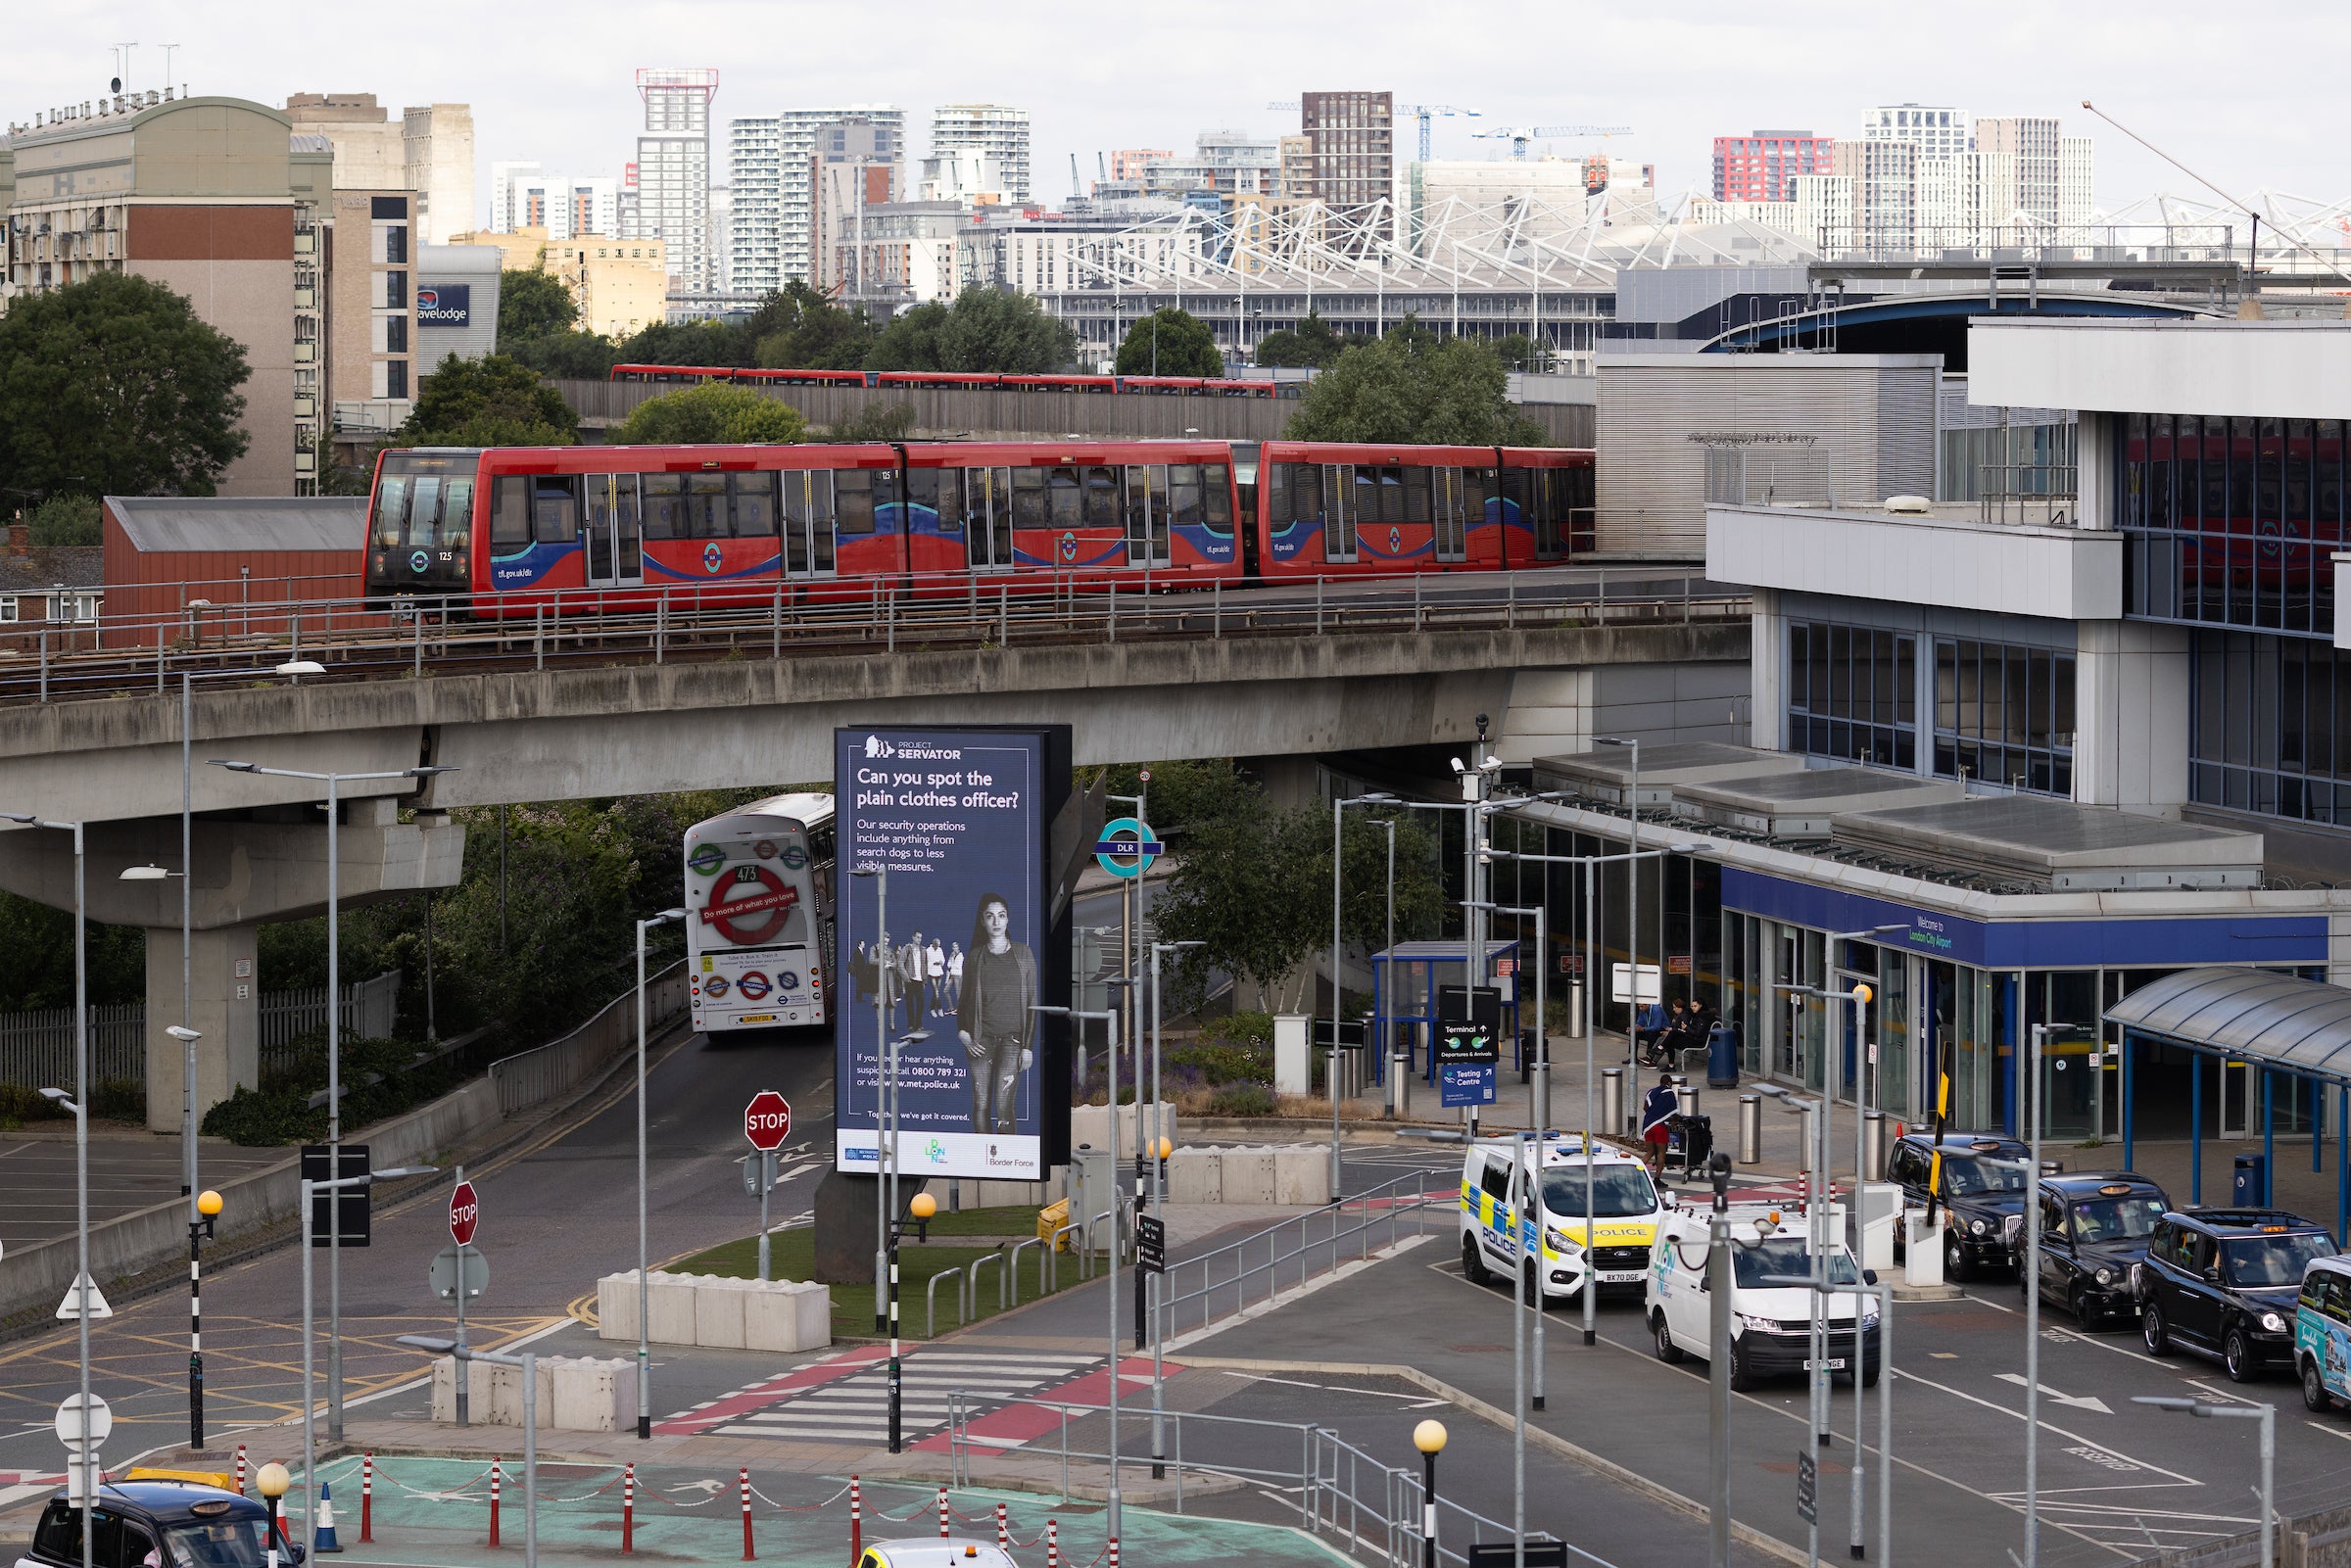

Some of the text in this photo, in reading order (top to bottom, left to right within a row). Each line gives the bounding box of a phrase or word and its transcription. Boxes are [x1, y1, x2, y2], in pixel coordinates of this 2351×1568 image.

[438, 551, 453, 562] 125
[898, 741, 932, 750] PROJECT
[897, 749, 961, 760] SERVATOR
[857, 768, 992, 789] Can you spot the
[857, 789, 1019, 809] plain clothes officer?
[857, 820, 966, 832] Our security operations
[856, 833, 955, 846] include anything from
[856, 848, 886, 857] search
[888, 848, 911, 860] dogs
[926, 849, 945, 858] less
[1117, 844, 1134, 853] DLR
[738, 868, 756, 880] 473
[715, 907, 735, 916] more
[736, 903, 744, 912] of
[744, 900, 764, 909] what
[764, 896, 779, 906] you
[780, 891, 794, 901] love
[1917, 915, 1938, 930] Welcome
[1909, 927, 1951, 950] London City Airport
[856, 1053, 862, 1062] If
[863, 1056, 878, 1065] you
[904, 1055, 921, 1064] hear
[923, 1056, 954, 1067] anything
[912, 1067, 935, 1076] 0800
[936, 1068, 952, 1077] 789
[953, 1069, 967, 1077] 321
[1457, 1069, 1481, 1078] Testing
[884, 1080, 960, 1090] ww.met.police.uk
[748, 1113, 789, 1130] STOP
[921, 1113, 932, 1121] got
[452, 1204, 477, 1226] STOP
[1482, 1226, 1515, 1256] POLICE
